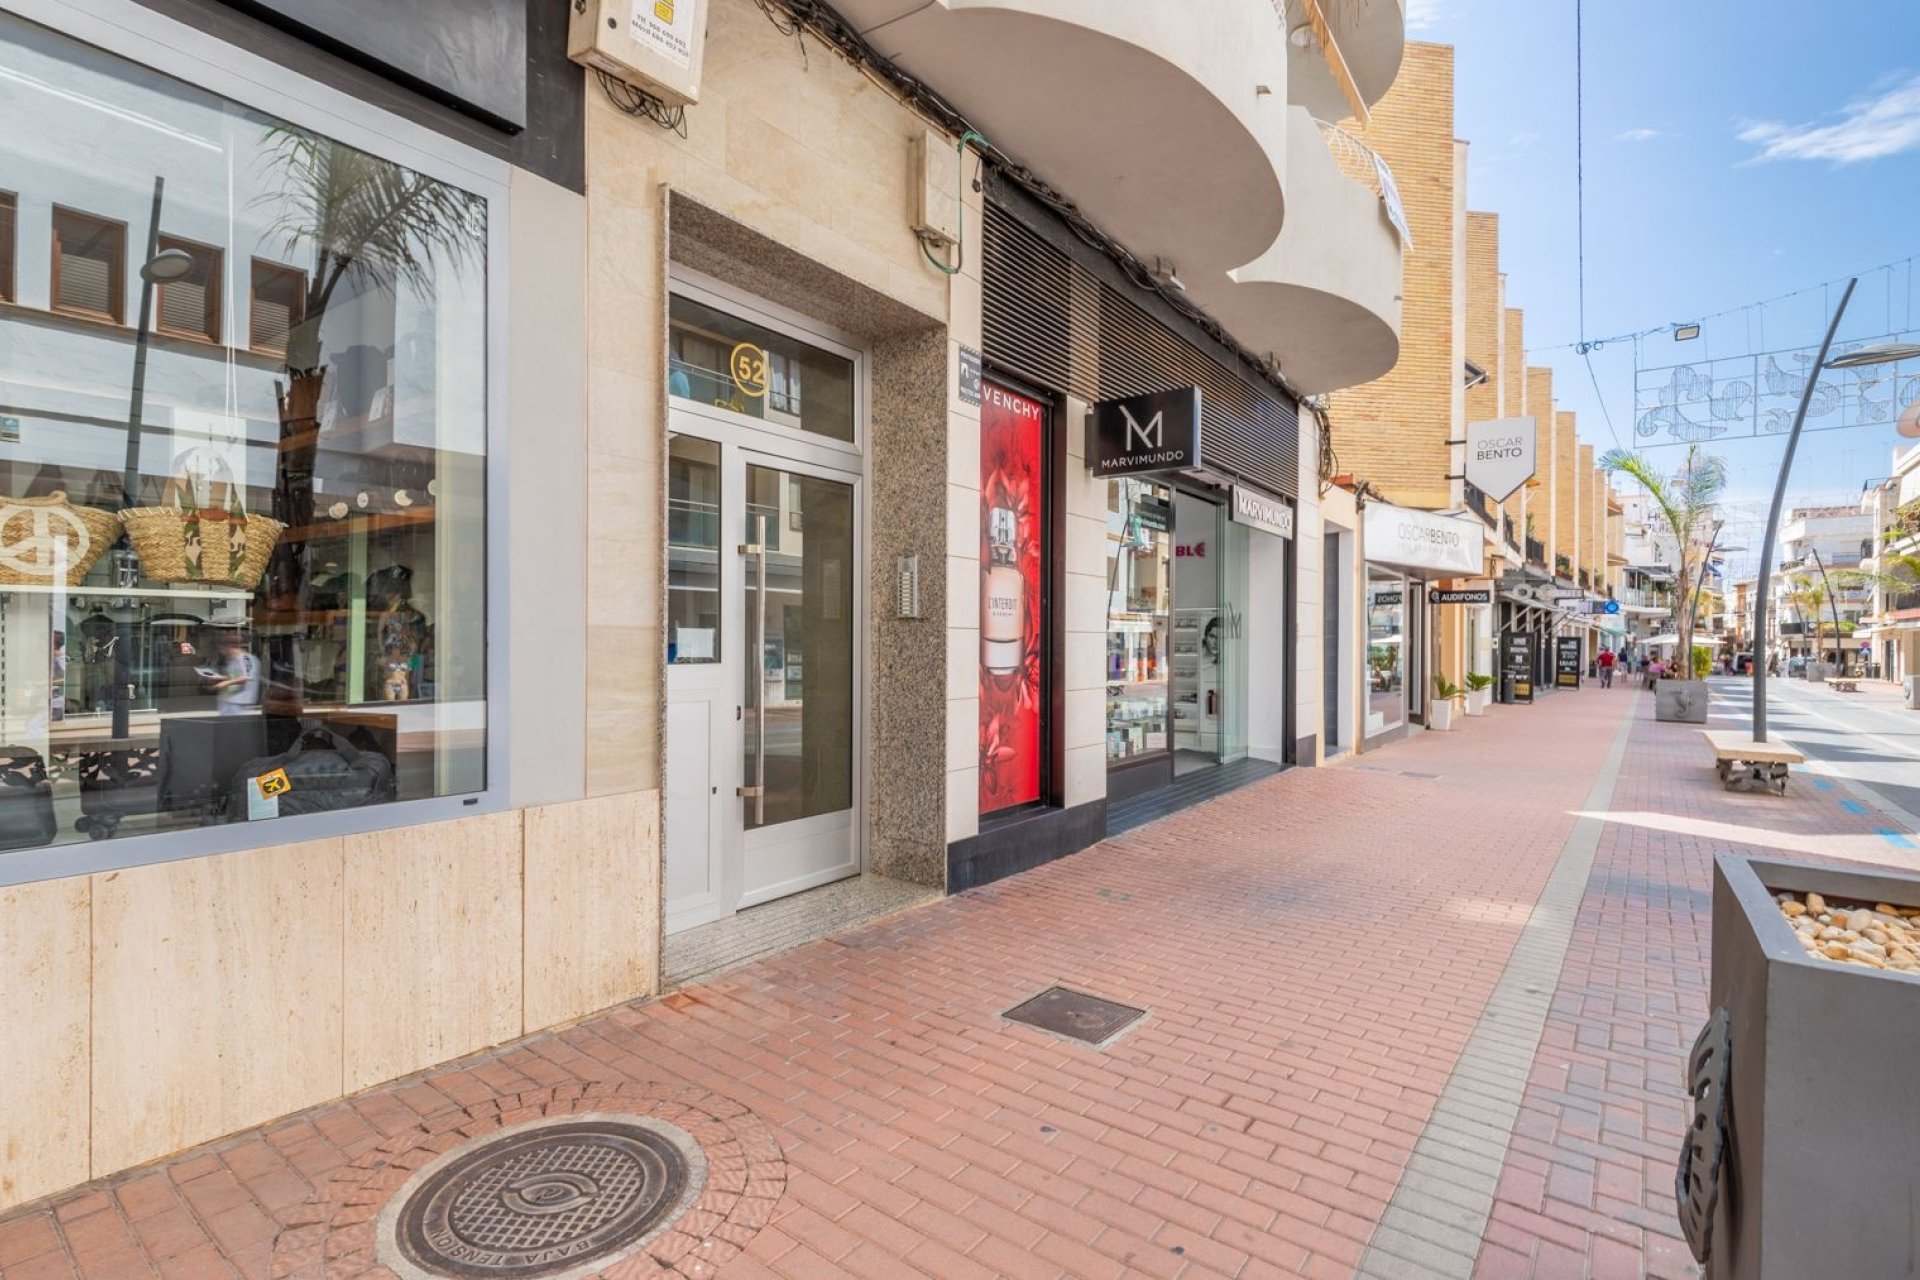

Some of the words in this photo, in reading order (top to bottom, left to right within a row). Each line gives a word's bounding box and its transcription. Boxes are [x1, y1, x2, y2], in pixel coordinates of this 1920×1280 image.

[739, 355, 766, 384] 52
[983, 385, 1040, 420] VENCHY
[1119, 405, 1163, 451] M
[1477, 437, 1523, 450] OSCAR
[1477, 447, 1523, 460] BENTO
[1101, 450, 1184, 469] MARVIMUNDO
[1441, 593, 1488, 601] AUDIFONOS
[431, 1230, 505, 1266] TENSION
[524, 1239, 590, 1266] BAJA
